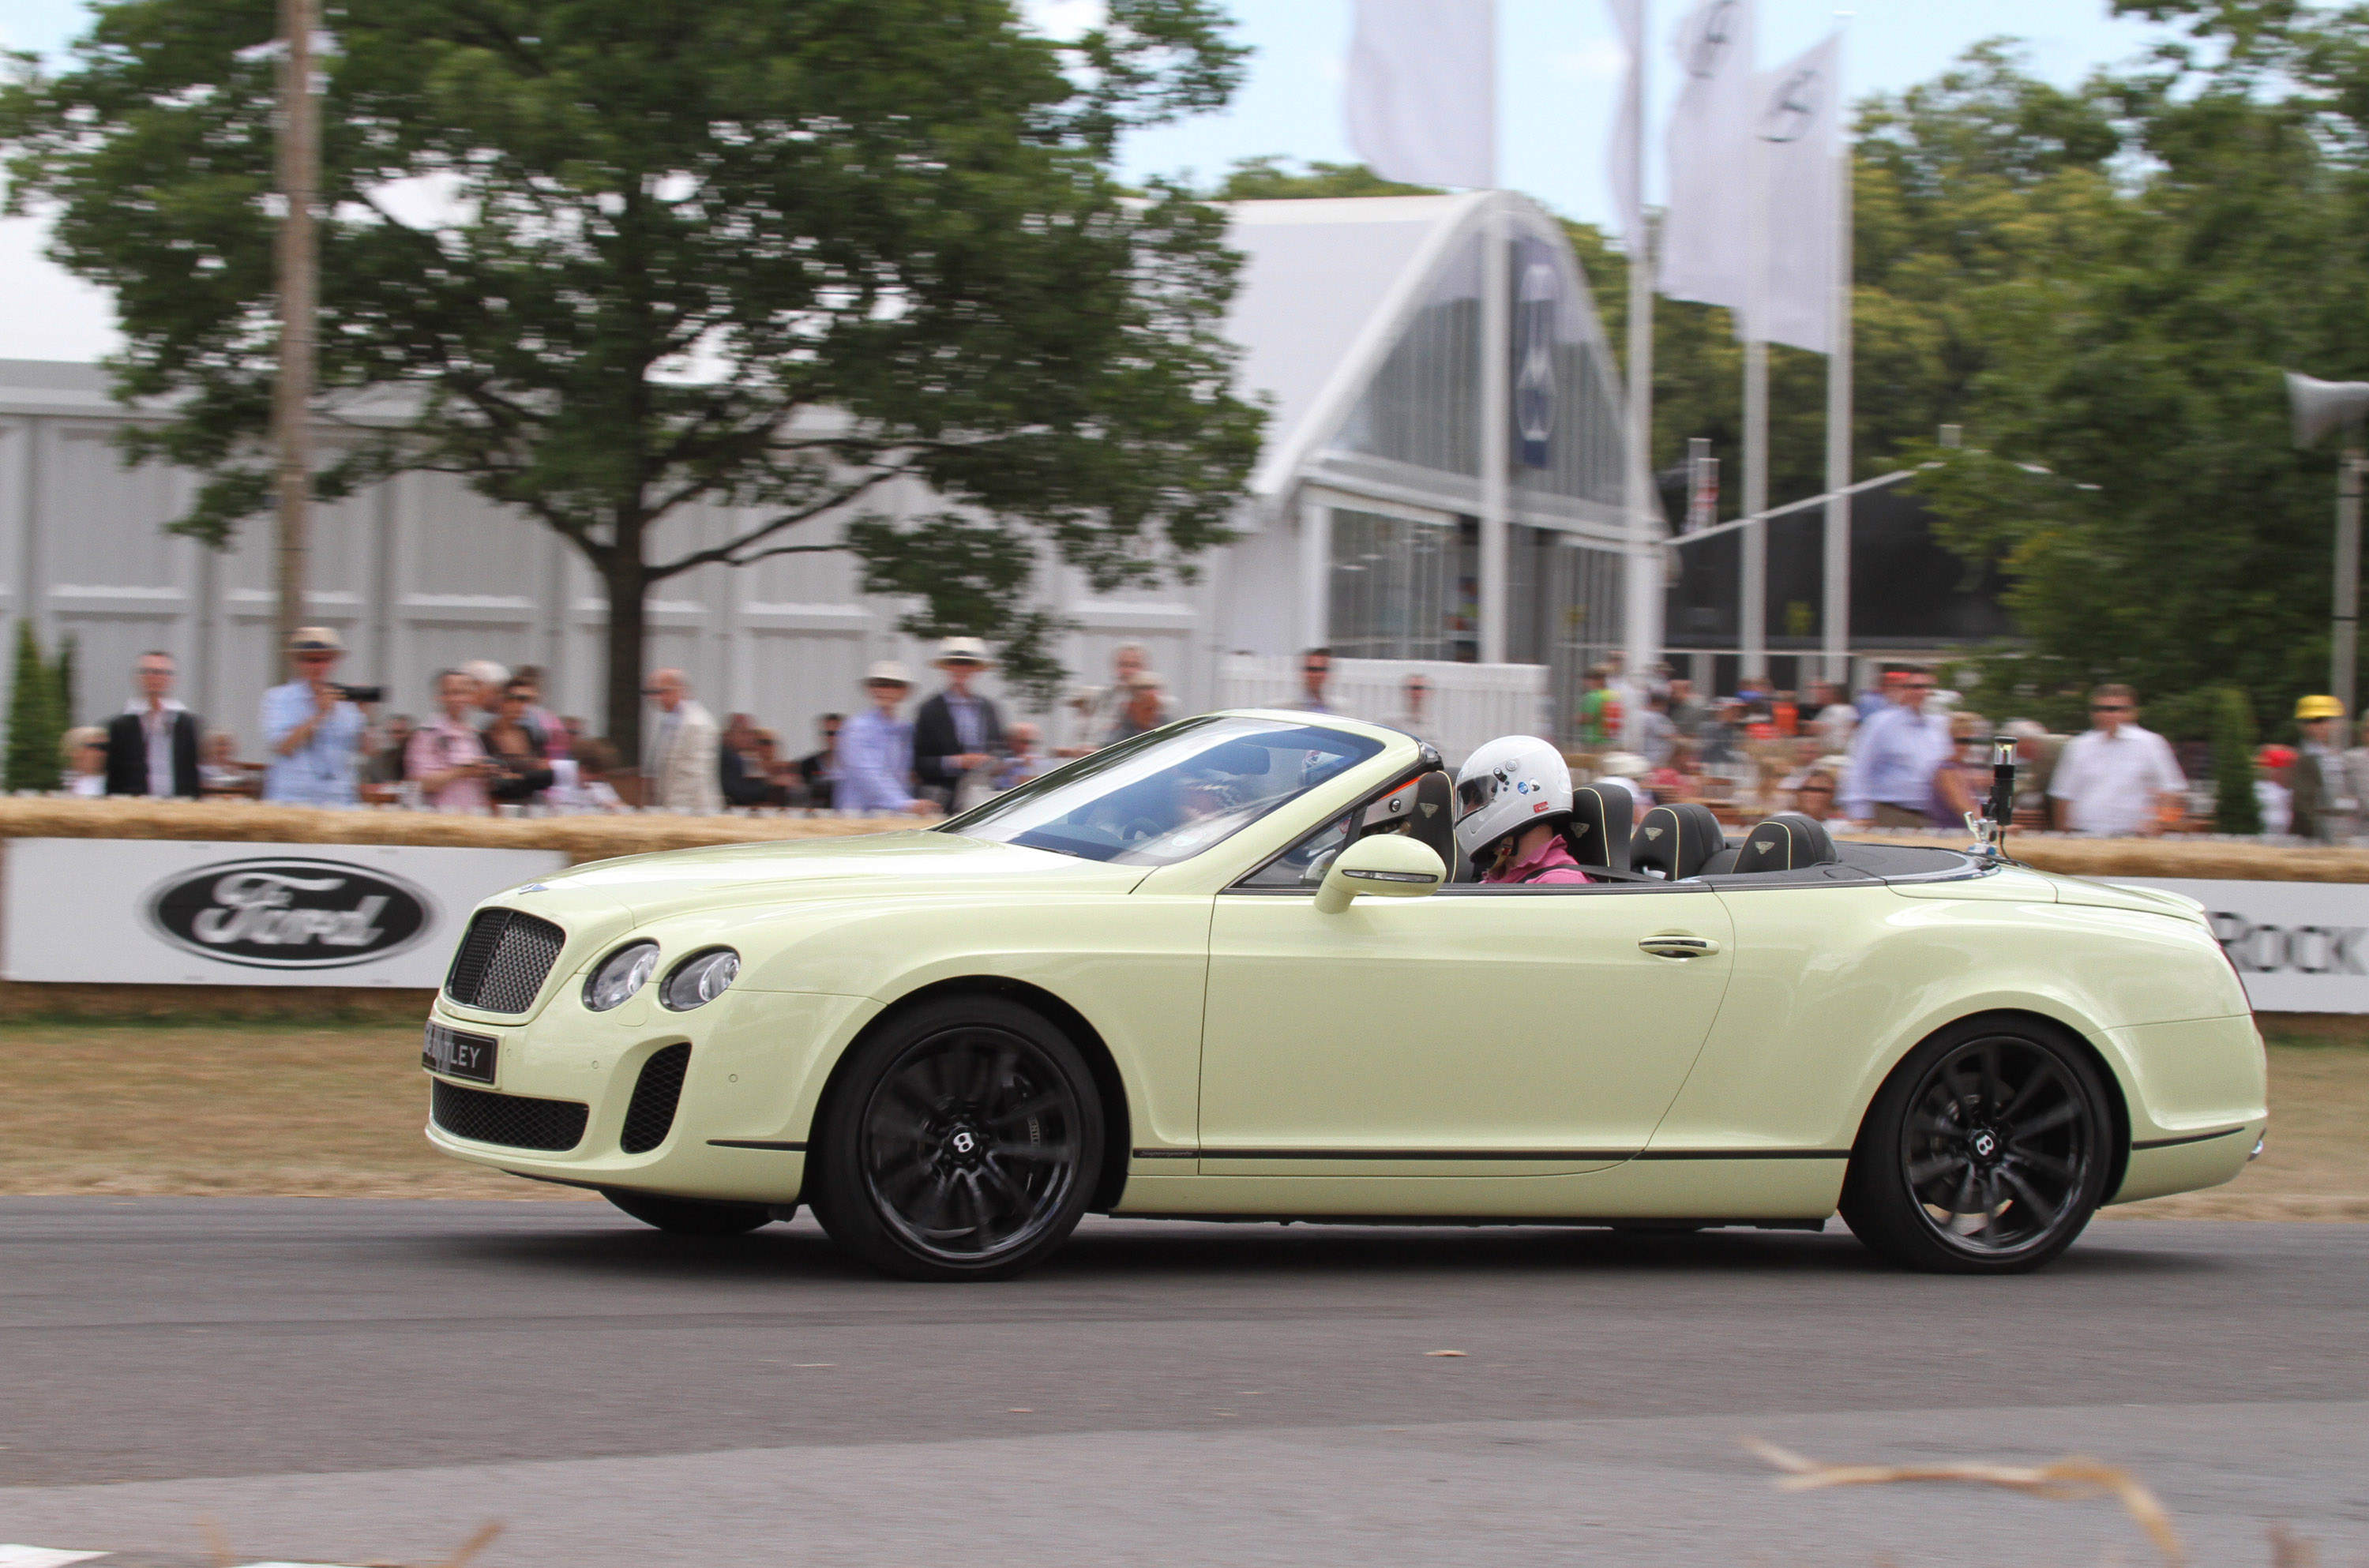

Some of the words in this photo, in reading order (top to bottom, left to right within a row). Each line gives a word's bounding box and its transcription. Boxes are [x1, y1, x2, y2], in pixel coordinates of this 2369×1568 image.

[191, 871, 392, 947] Ford
[953, 1132, 974, 1153] B
[1976, 1134, 1995, 1156] B
